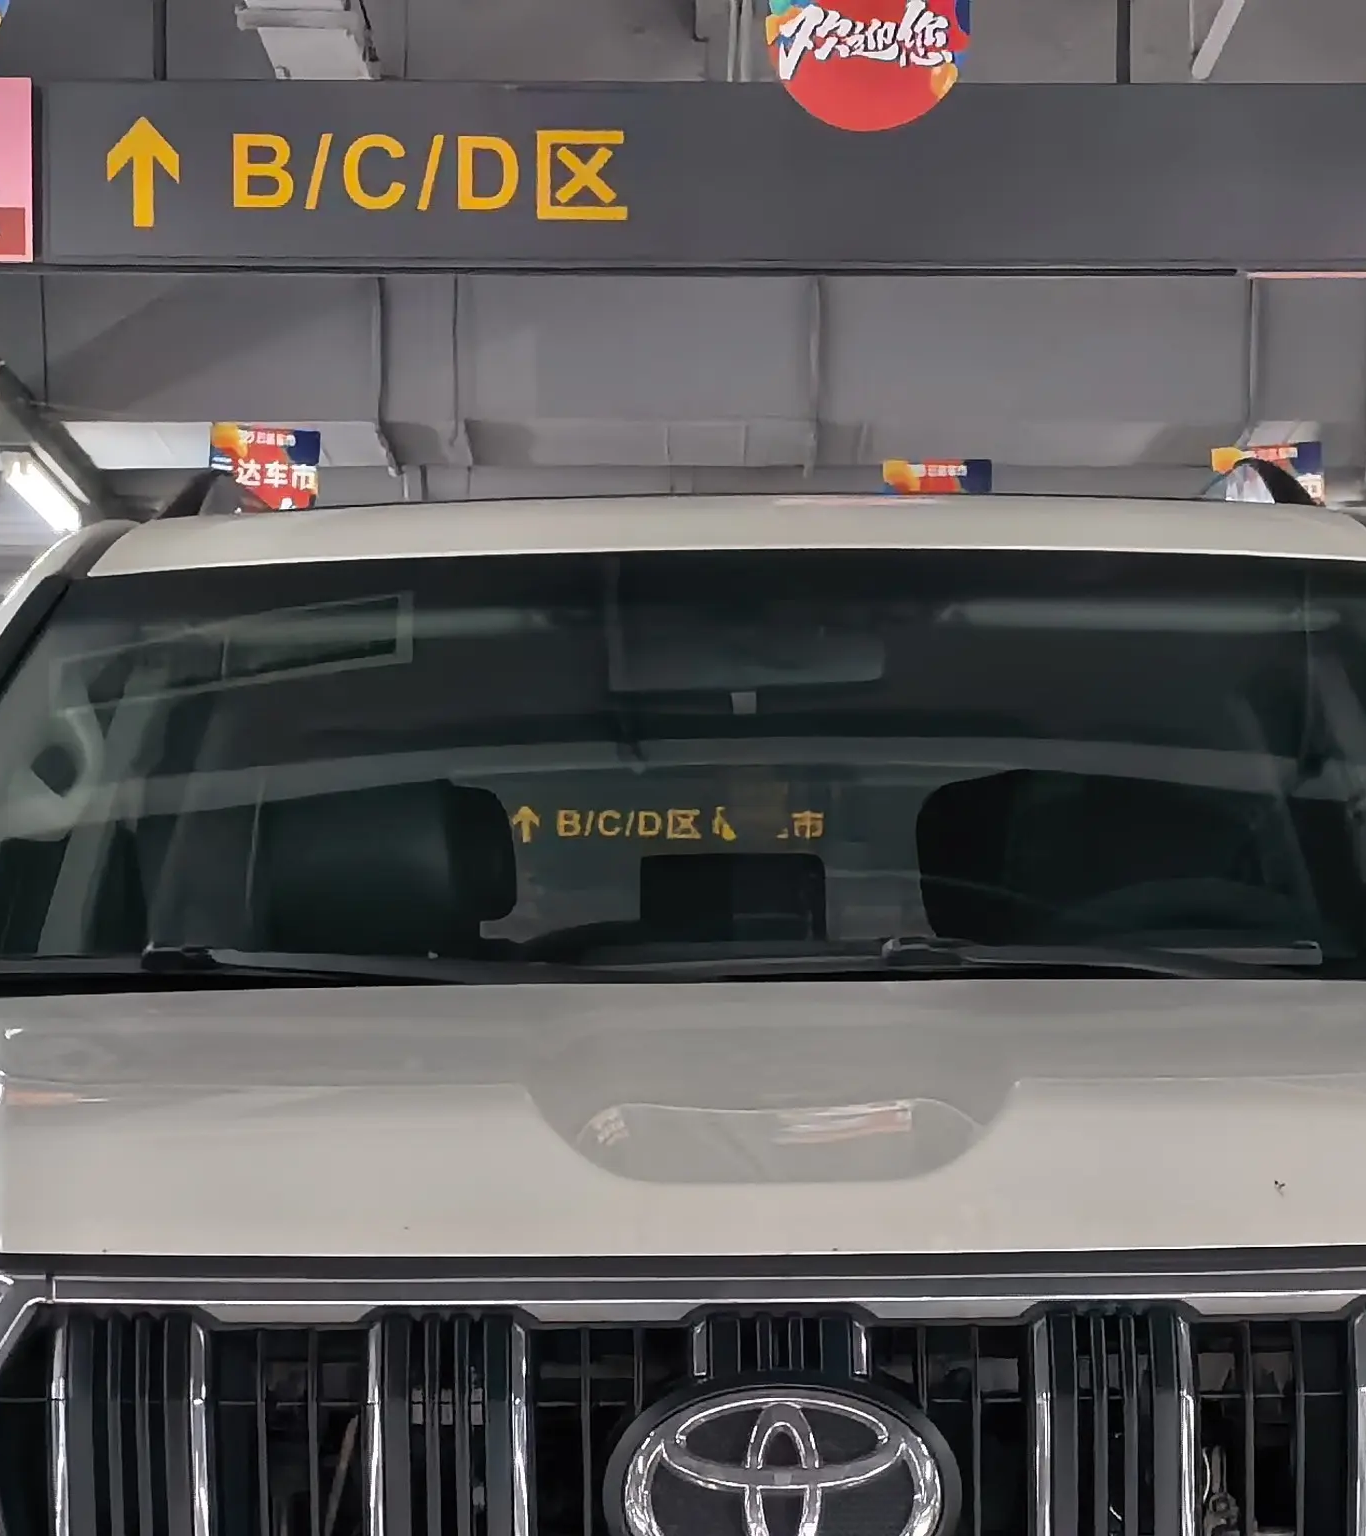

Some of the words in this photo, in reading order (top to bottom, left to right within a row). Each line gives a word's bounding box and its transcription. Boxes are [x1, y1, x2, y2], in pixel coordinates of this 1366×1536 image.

[778, 0, 954, 81] 欢迎您
[233, 130, 628, 221] B/C/D区
